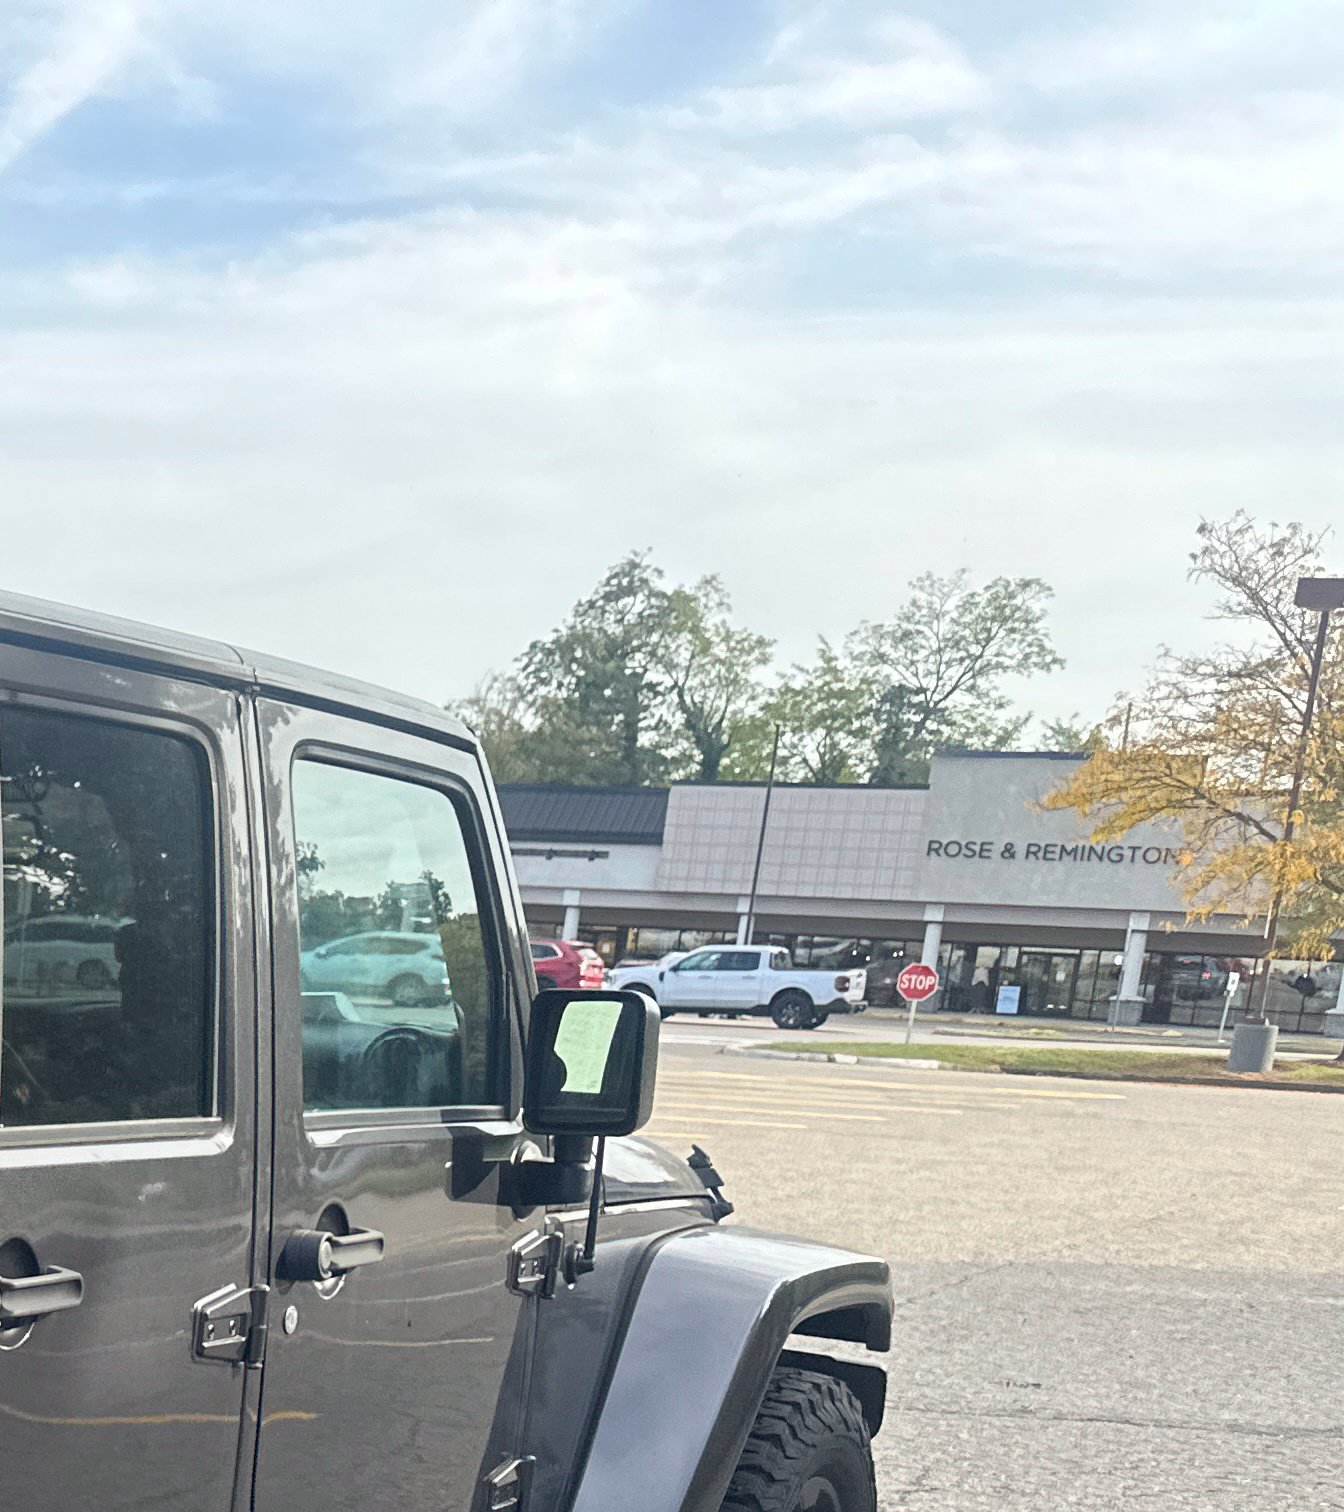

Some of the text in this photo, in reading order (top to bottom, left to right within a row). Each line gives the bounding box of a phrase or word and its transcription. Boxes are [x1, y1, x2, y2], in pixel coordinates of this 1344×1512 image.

[926, 840, 1183, 865] ROSE & REMINGTON
[900, 974, 936, 991] STOP
